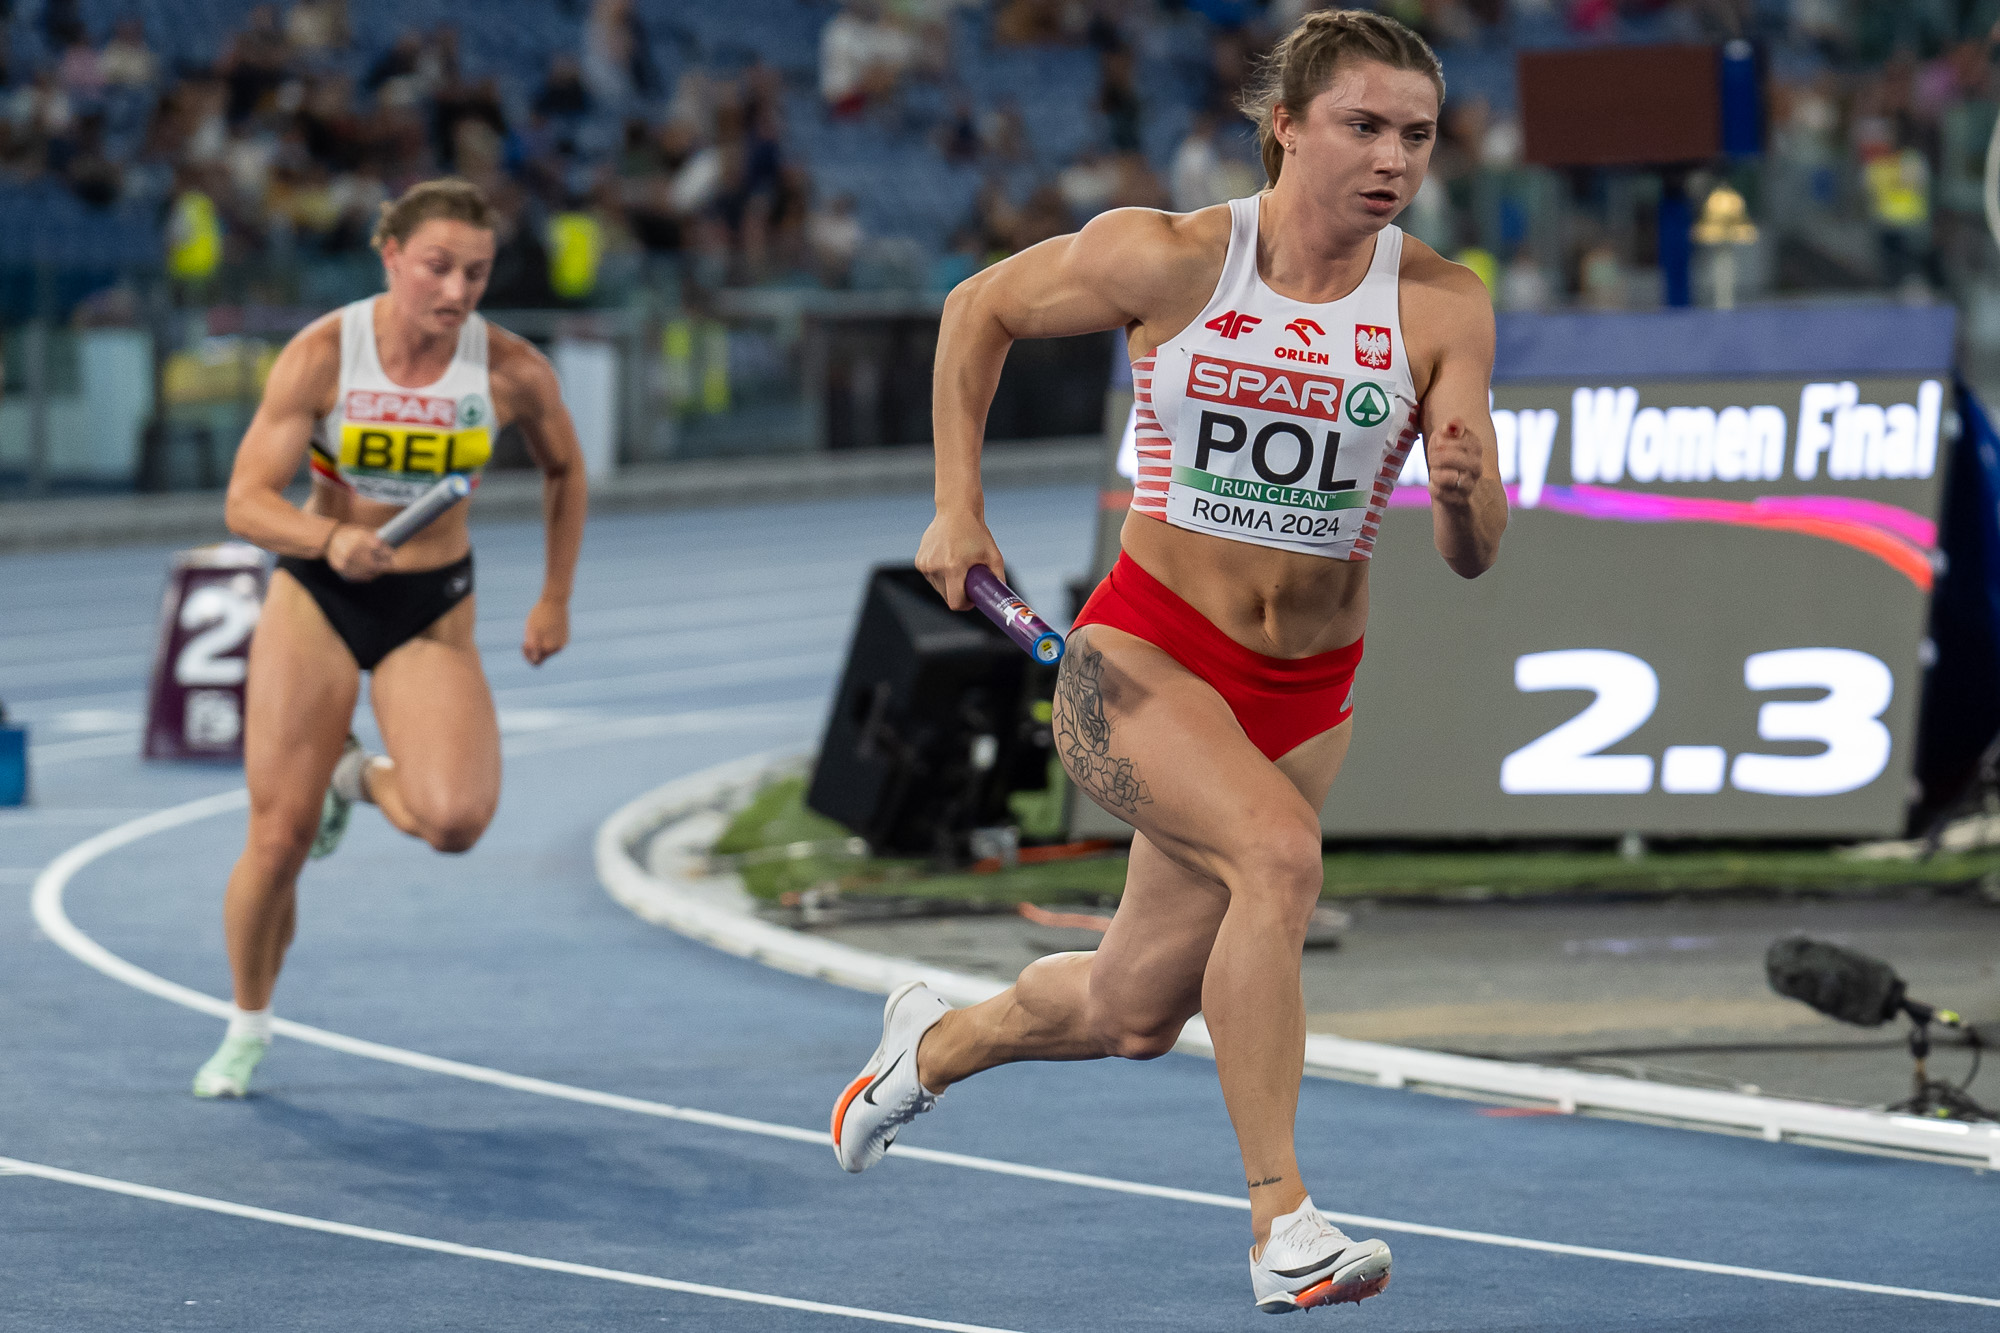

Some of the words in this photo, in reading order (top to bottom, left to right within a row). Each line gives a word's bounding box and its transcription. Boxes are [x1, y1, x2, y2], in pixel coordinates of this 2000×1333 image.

[1205, 310, 1262, 340] 4F
[1274, 346, 1329, 365] ORLEN
[349, 393, 453, 426] SPAR
[1192, 362, 1338, 415] SPAR
[1194, 410, 1357, 491] POL
[1571, 386, 1786, 482] Women
[1794, 379, 1943, 481] Final
[358, 431, 474, 474] BEL
[1211, 477, 1217, 491] I
[1220, 480, 1261, 499] RUN
[1192, 497, 1273, 531] ROMA
[1280, 513, 1340, 537] 2024
[177, 586, 260, 685] 2
[1500, 648, 1894, 797] 2.3
